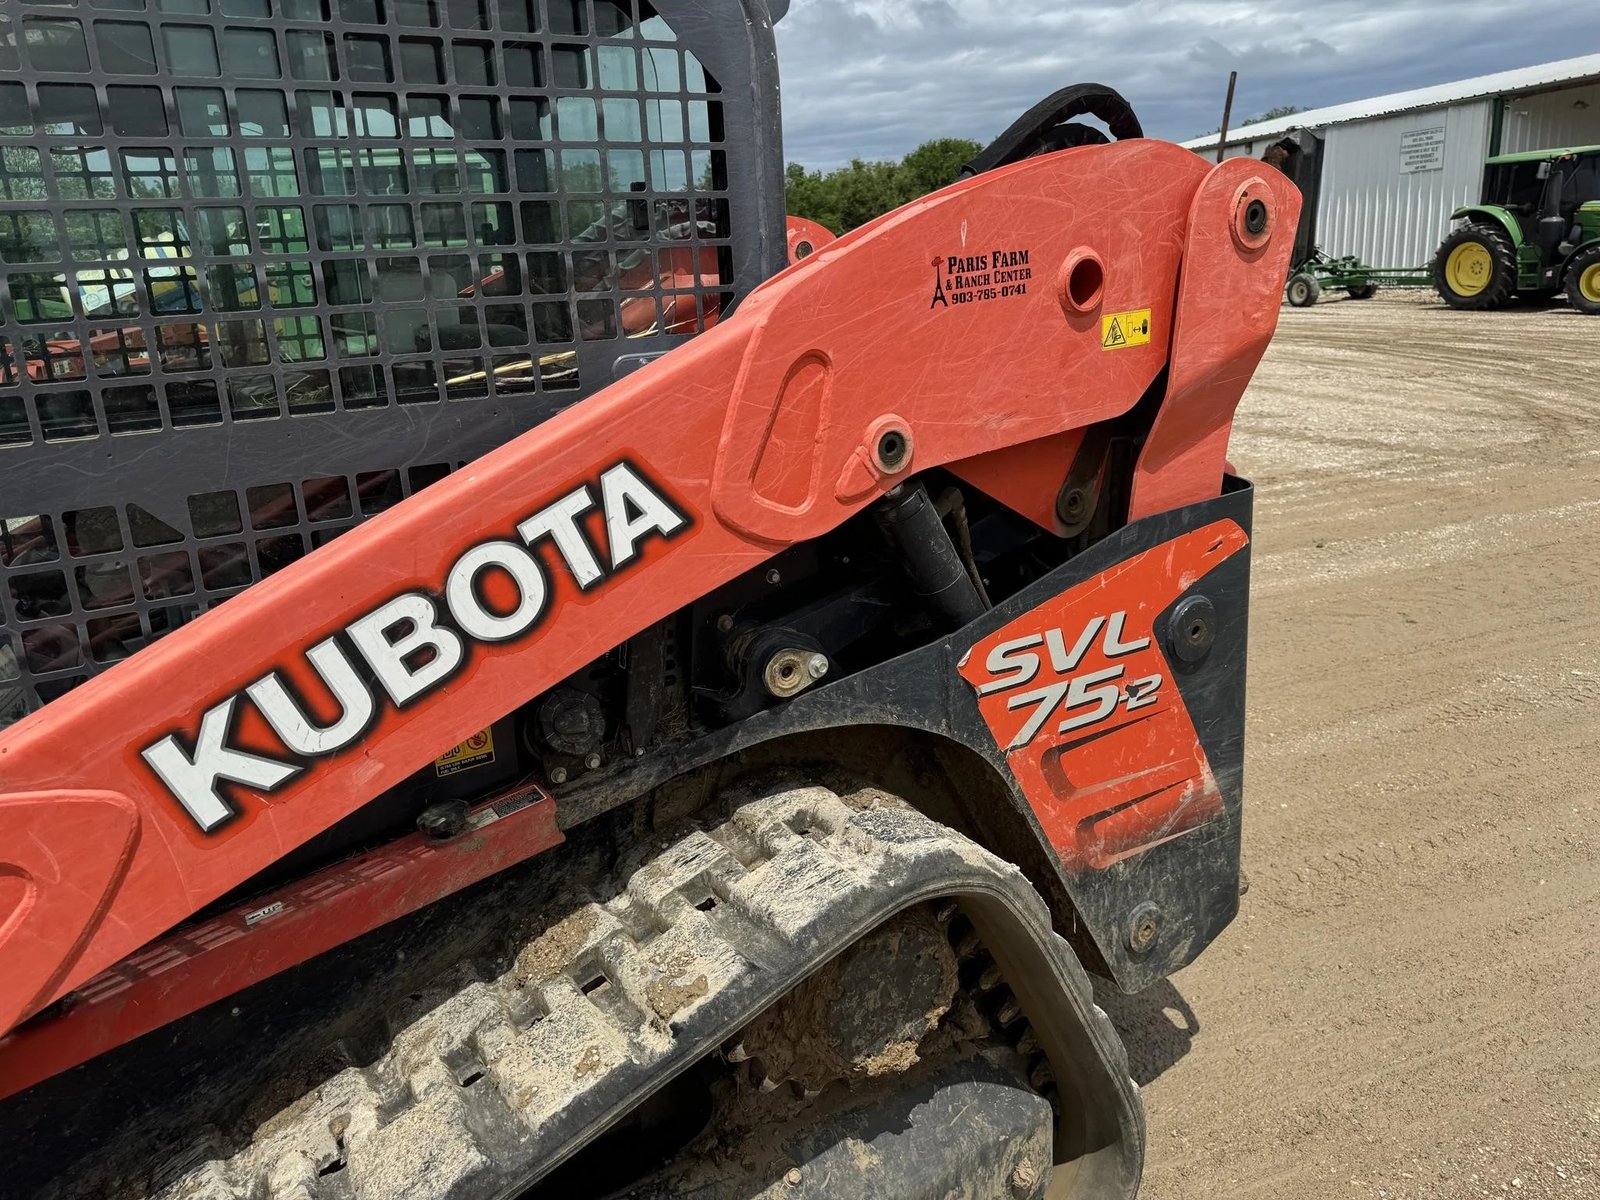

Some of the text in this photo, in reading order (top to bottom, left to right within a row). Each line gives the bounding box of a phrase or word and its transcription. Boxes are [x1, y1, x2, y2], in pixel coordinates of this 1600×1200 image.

[947, 249, 1029, 275] PARIS FARM
[945, 267, 1032, 291] & RANCH CENTER
[951, 283, 1027, 305] 903-785-0741
[141, 462, 689, 832] KUBOTA
[979, 610, 1151, 694] SVL
[1003, 664, 1163, 751] 75-2
[262, 904, 281, 915] UP
